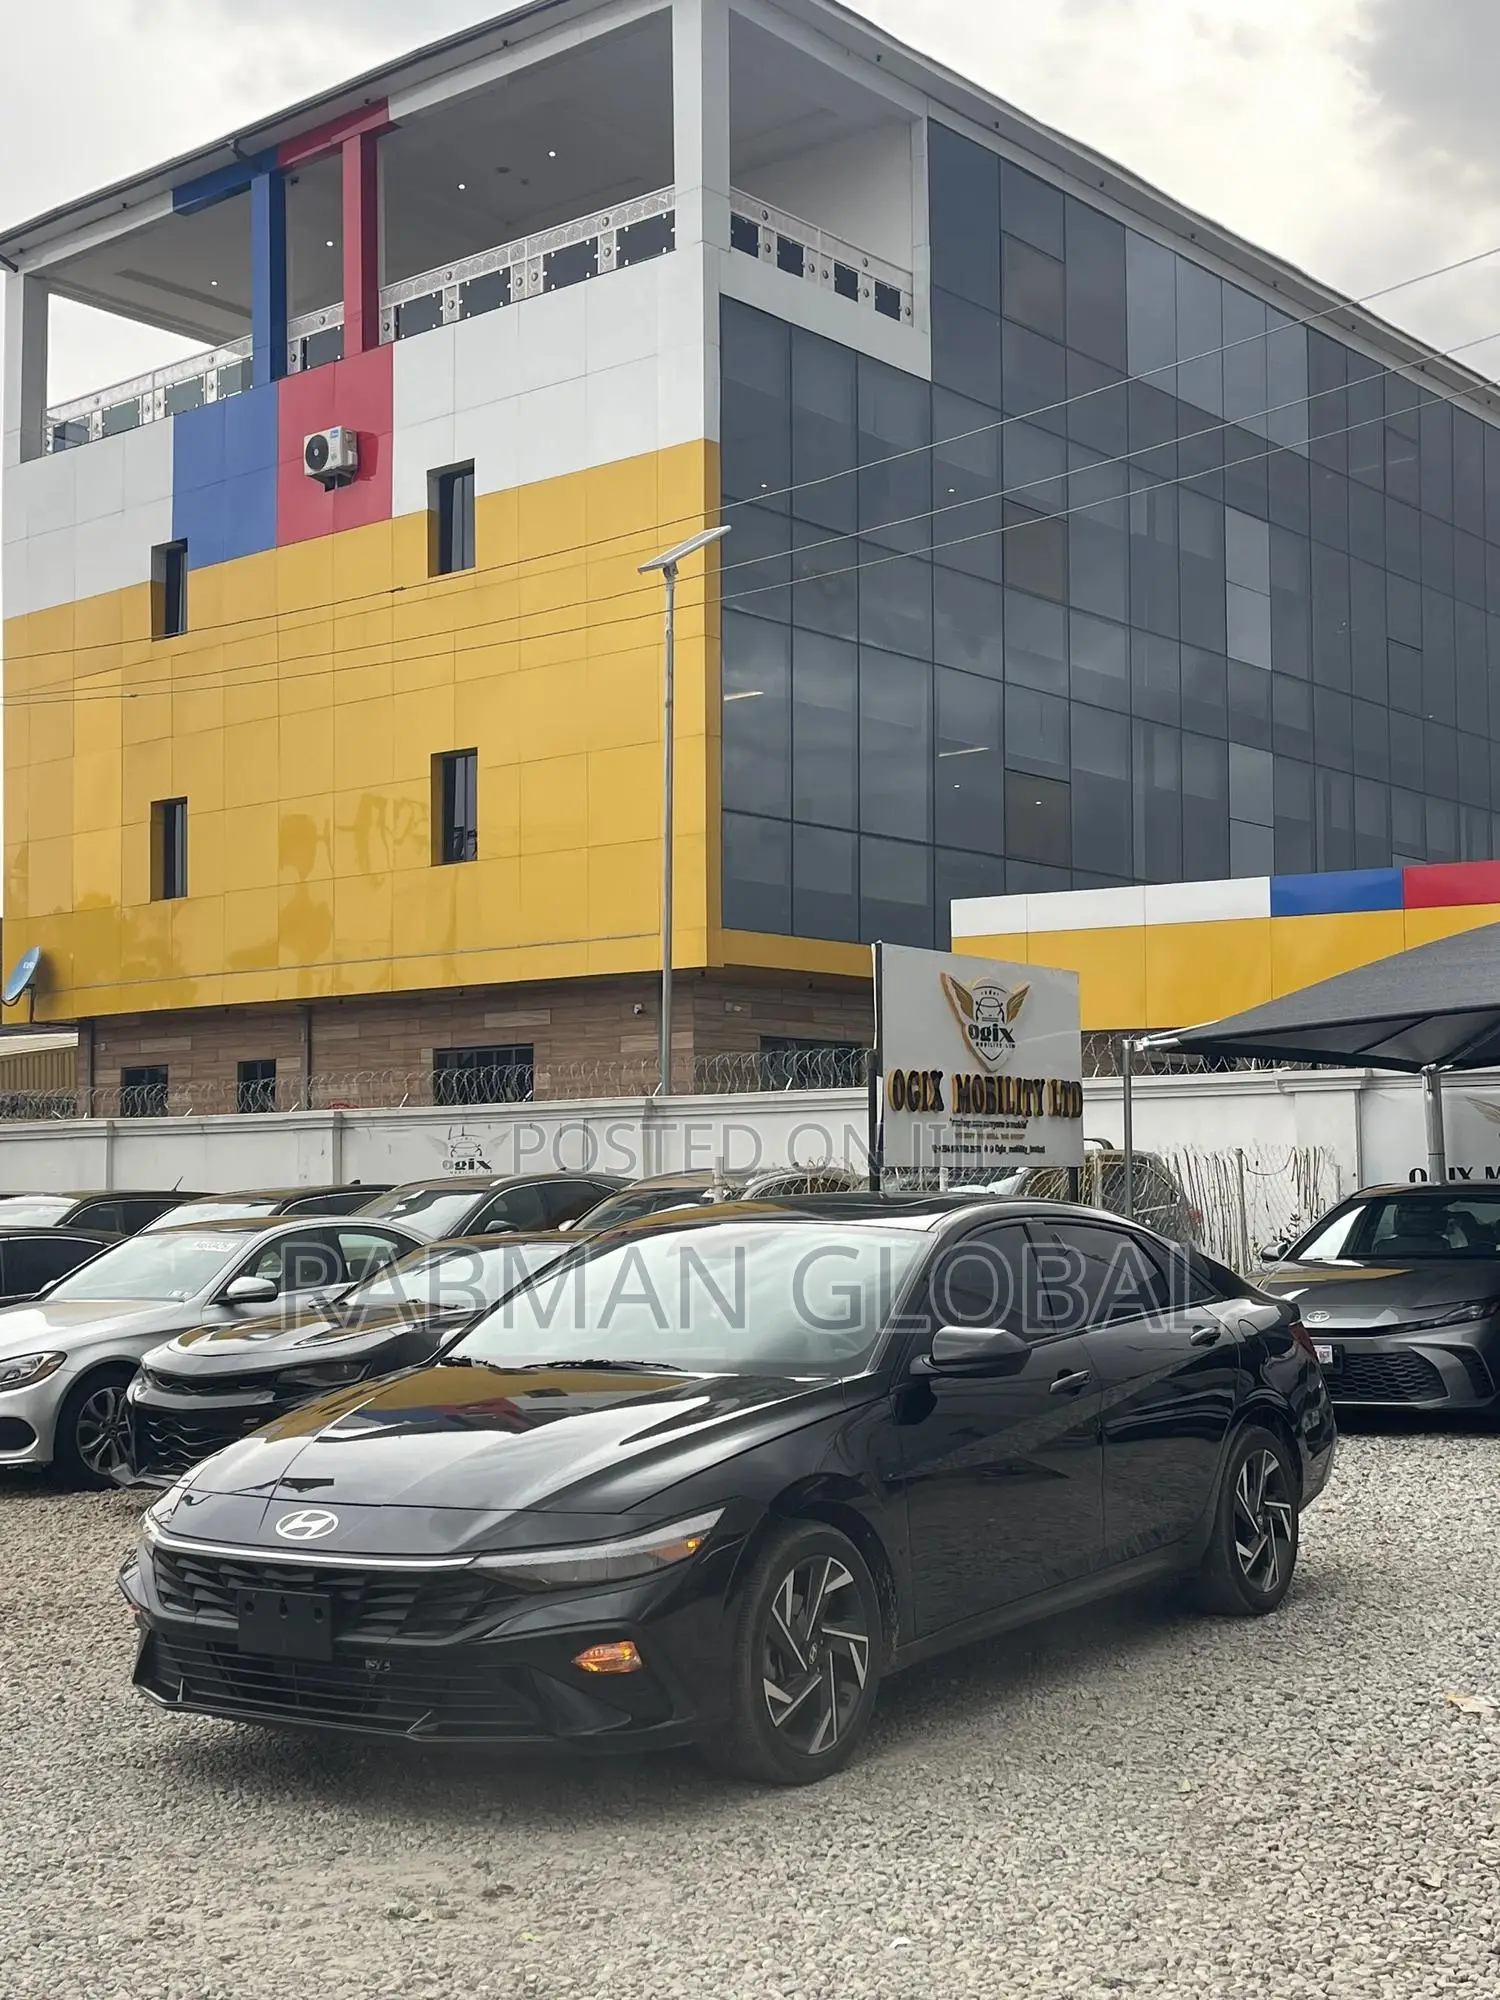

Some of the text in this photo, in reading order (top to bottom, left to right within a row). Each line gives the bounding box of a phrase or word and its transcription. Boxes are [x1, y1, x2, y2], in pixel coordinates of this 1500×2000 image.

[888, 1068, 1083, 1118] OGIX MOBILITY LTD
[1409, 1166, 1473, 1183] OIX
